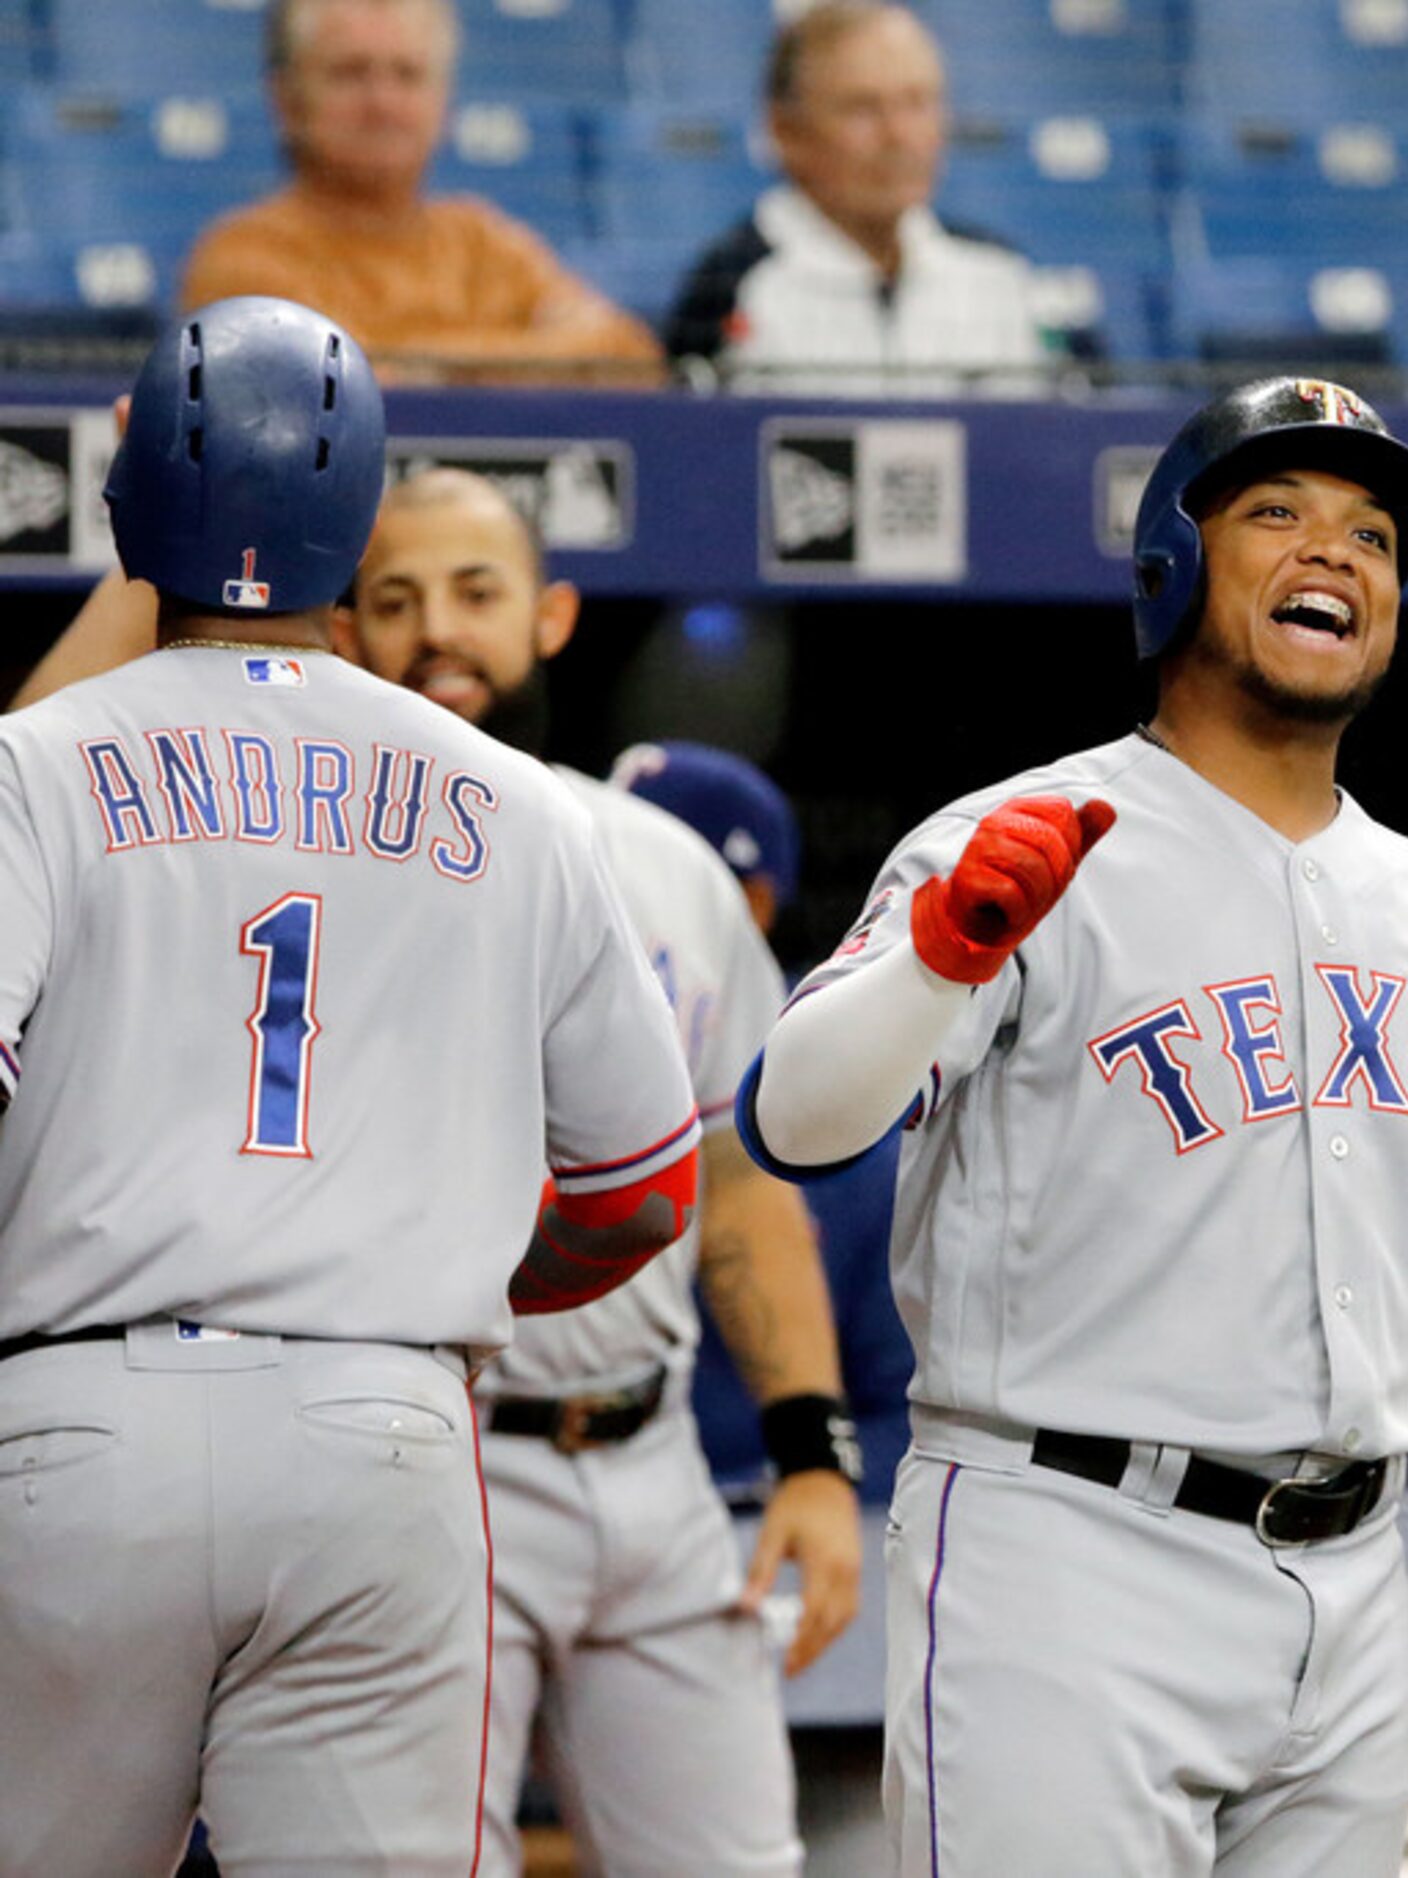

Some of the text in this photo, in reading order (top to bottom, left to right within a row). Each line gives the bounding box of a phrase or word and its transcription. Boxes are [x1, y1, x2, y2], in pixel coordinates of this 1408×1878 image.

[1294, 378, 1361, 426] T
[241, 546, 257, 581] 1
[77, 727, 500, 883] ANDRUS
[238, 890, 323, 1161] 1
